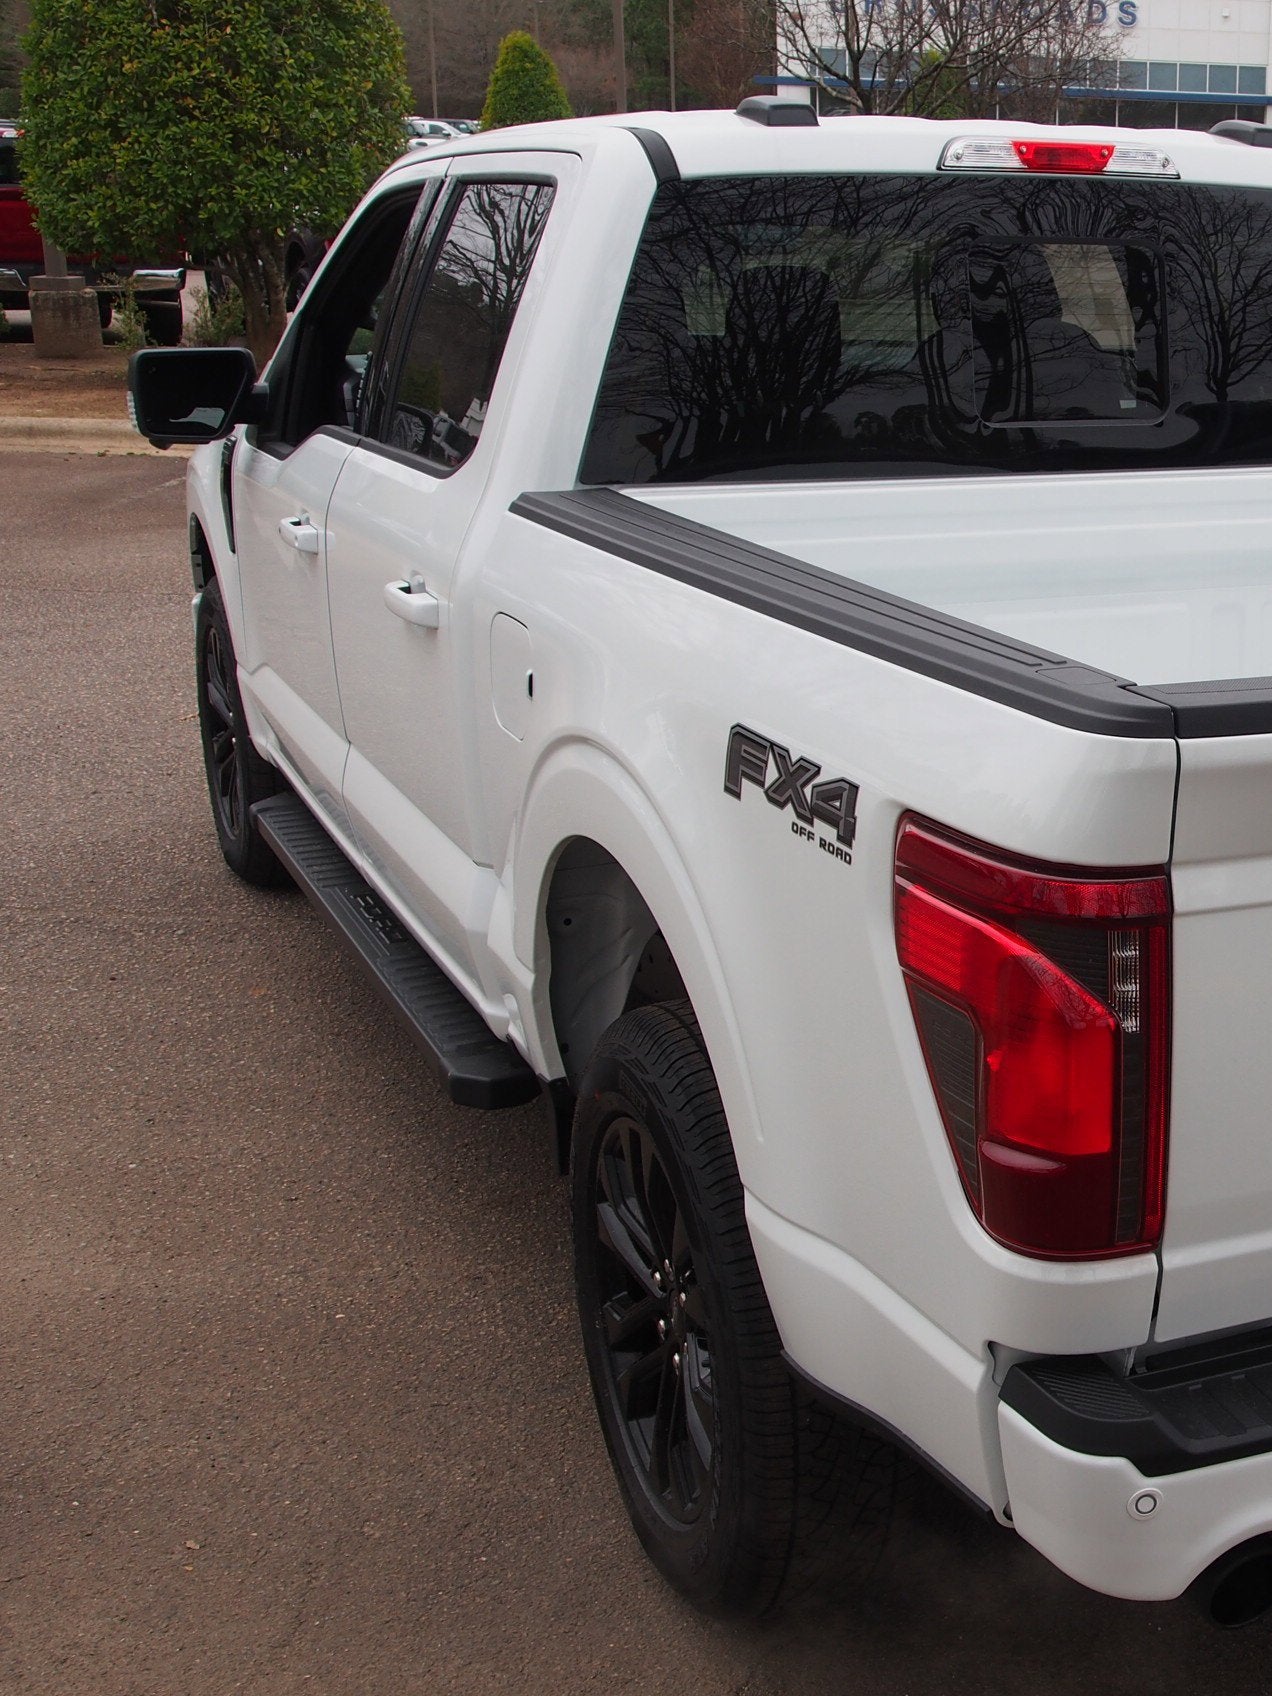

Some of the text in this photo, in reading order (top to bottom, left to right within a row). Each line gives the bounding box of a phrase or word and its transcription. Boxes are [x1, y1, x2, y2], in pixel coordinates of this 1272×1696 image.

[724, 722, 860, 850] FX4
[791, 821, 853, 866] OFF ROAD
